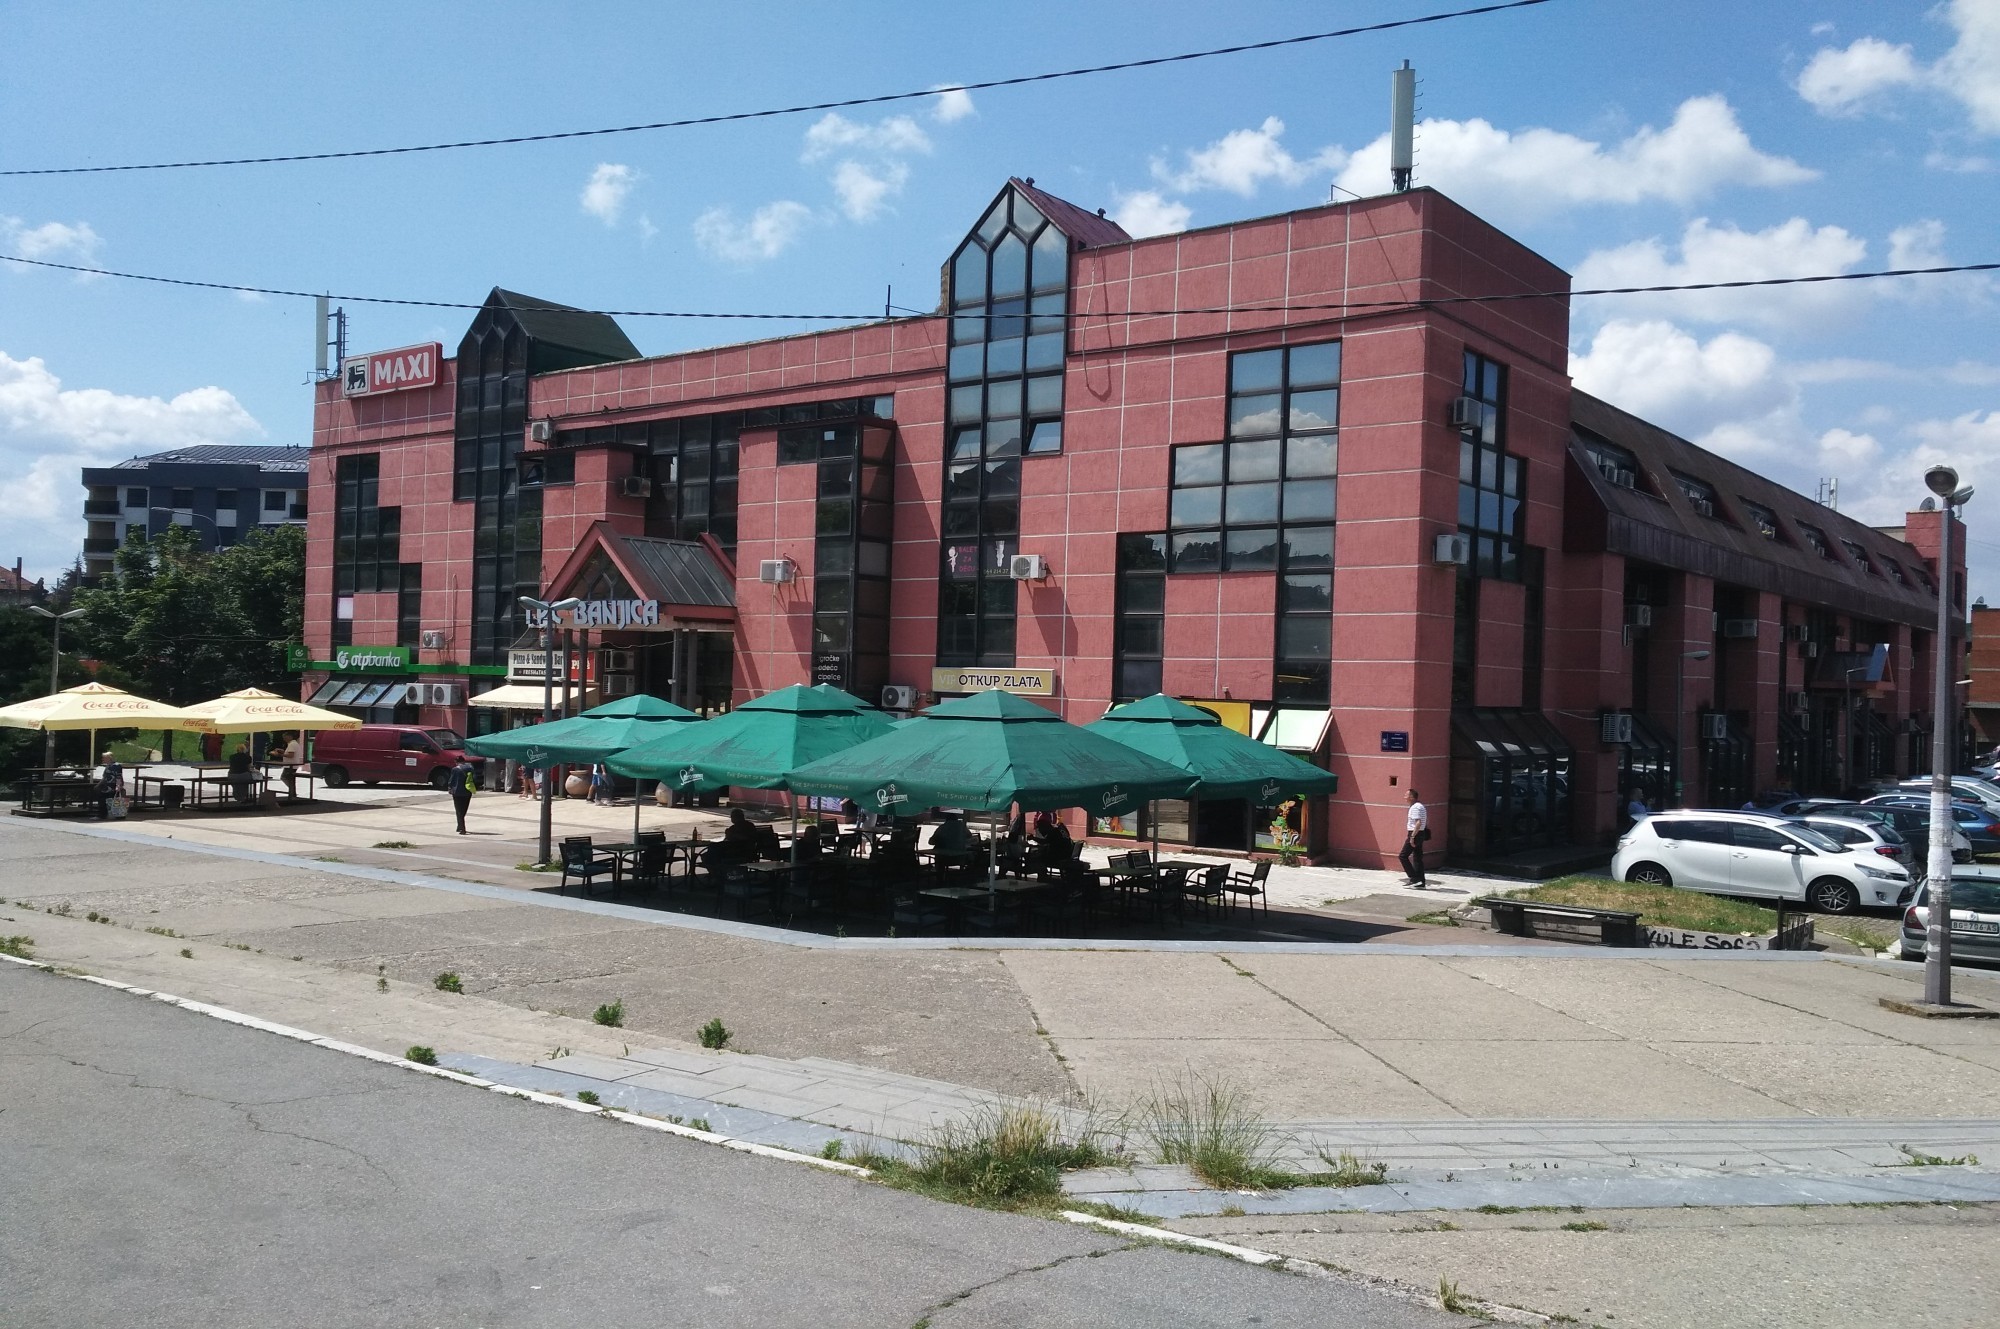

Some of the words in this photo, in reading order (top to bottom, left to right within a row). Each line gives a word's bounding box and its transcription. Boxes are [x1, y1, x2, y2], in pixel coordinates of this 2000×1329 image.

[374, 351, 430, 386] MAXI
[573, 600, 658, 630] BANJICA
[531, 653, 552, 665] Sandw
[818, 654, 840, 663] gračke
[958, 674, 1001, 687] OTKUP
[1003, 675, 1042, 688] ZLATA
[82, 700, 151, 711] Coca-Cola
[245, 705, 304, 715] Coca-Cola
[979, 796, 1001, 804] PAGUE
